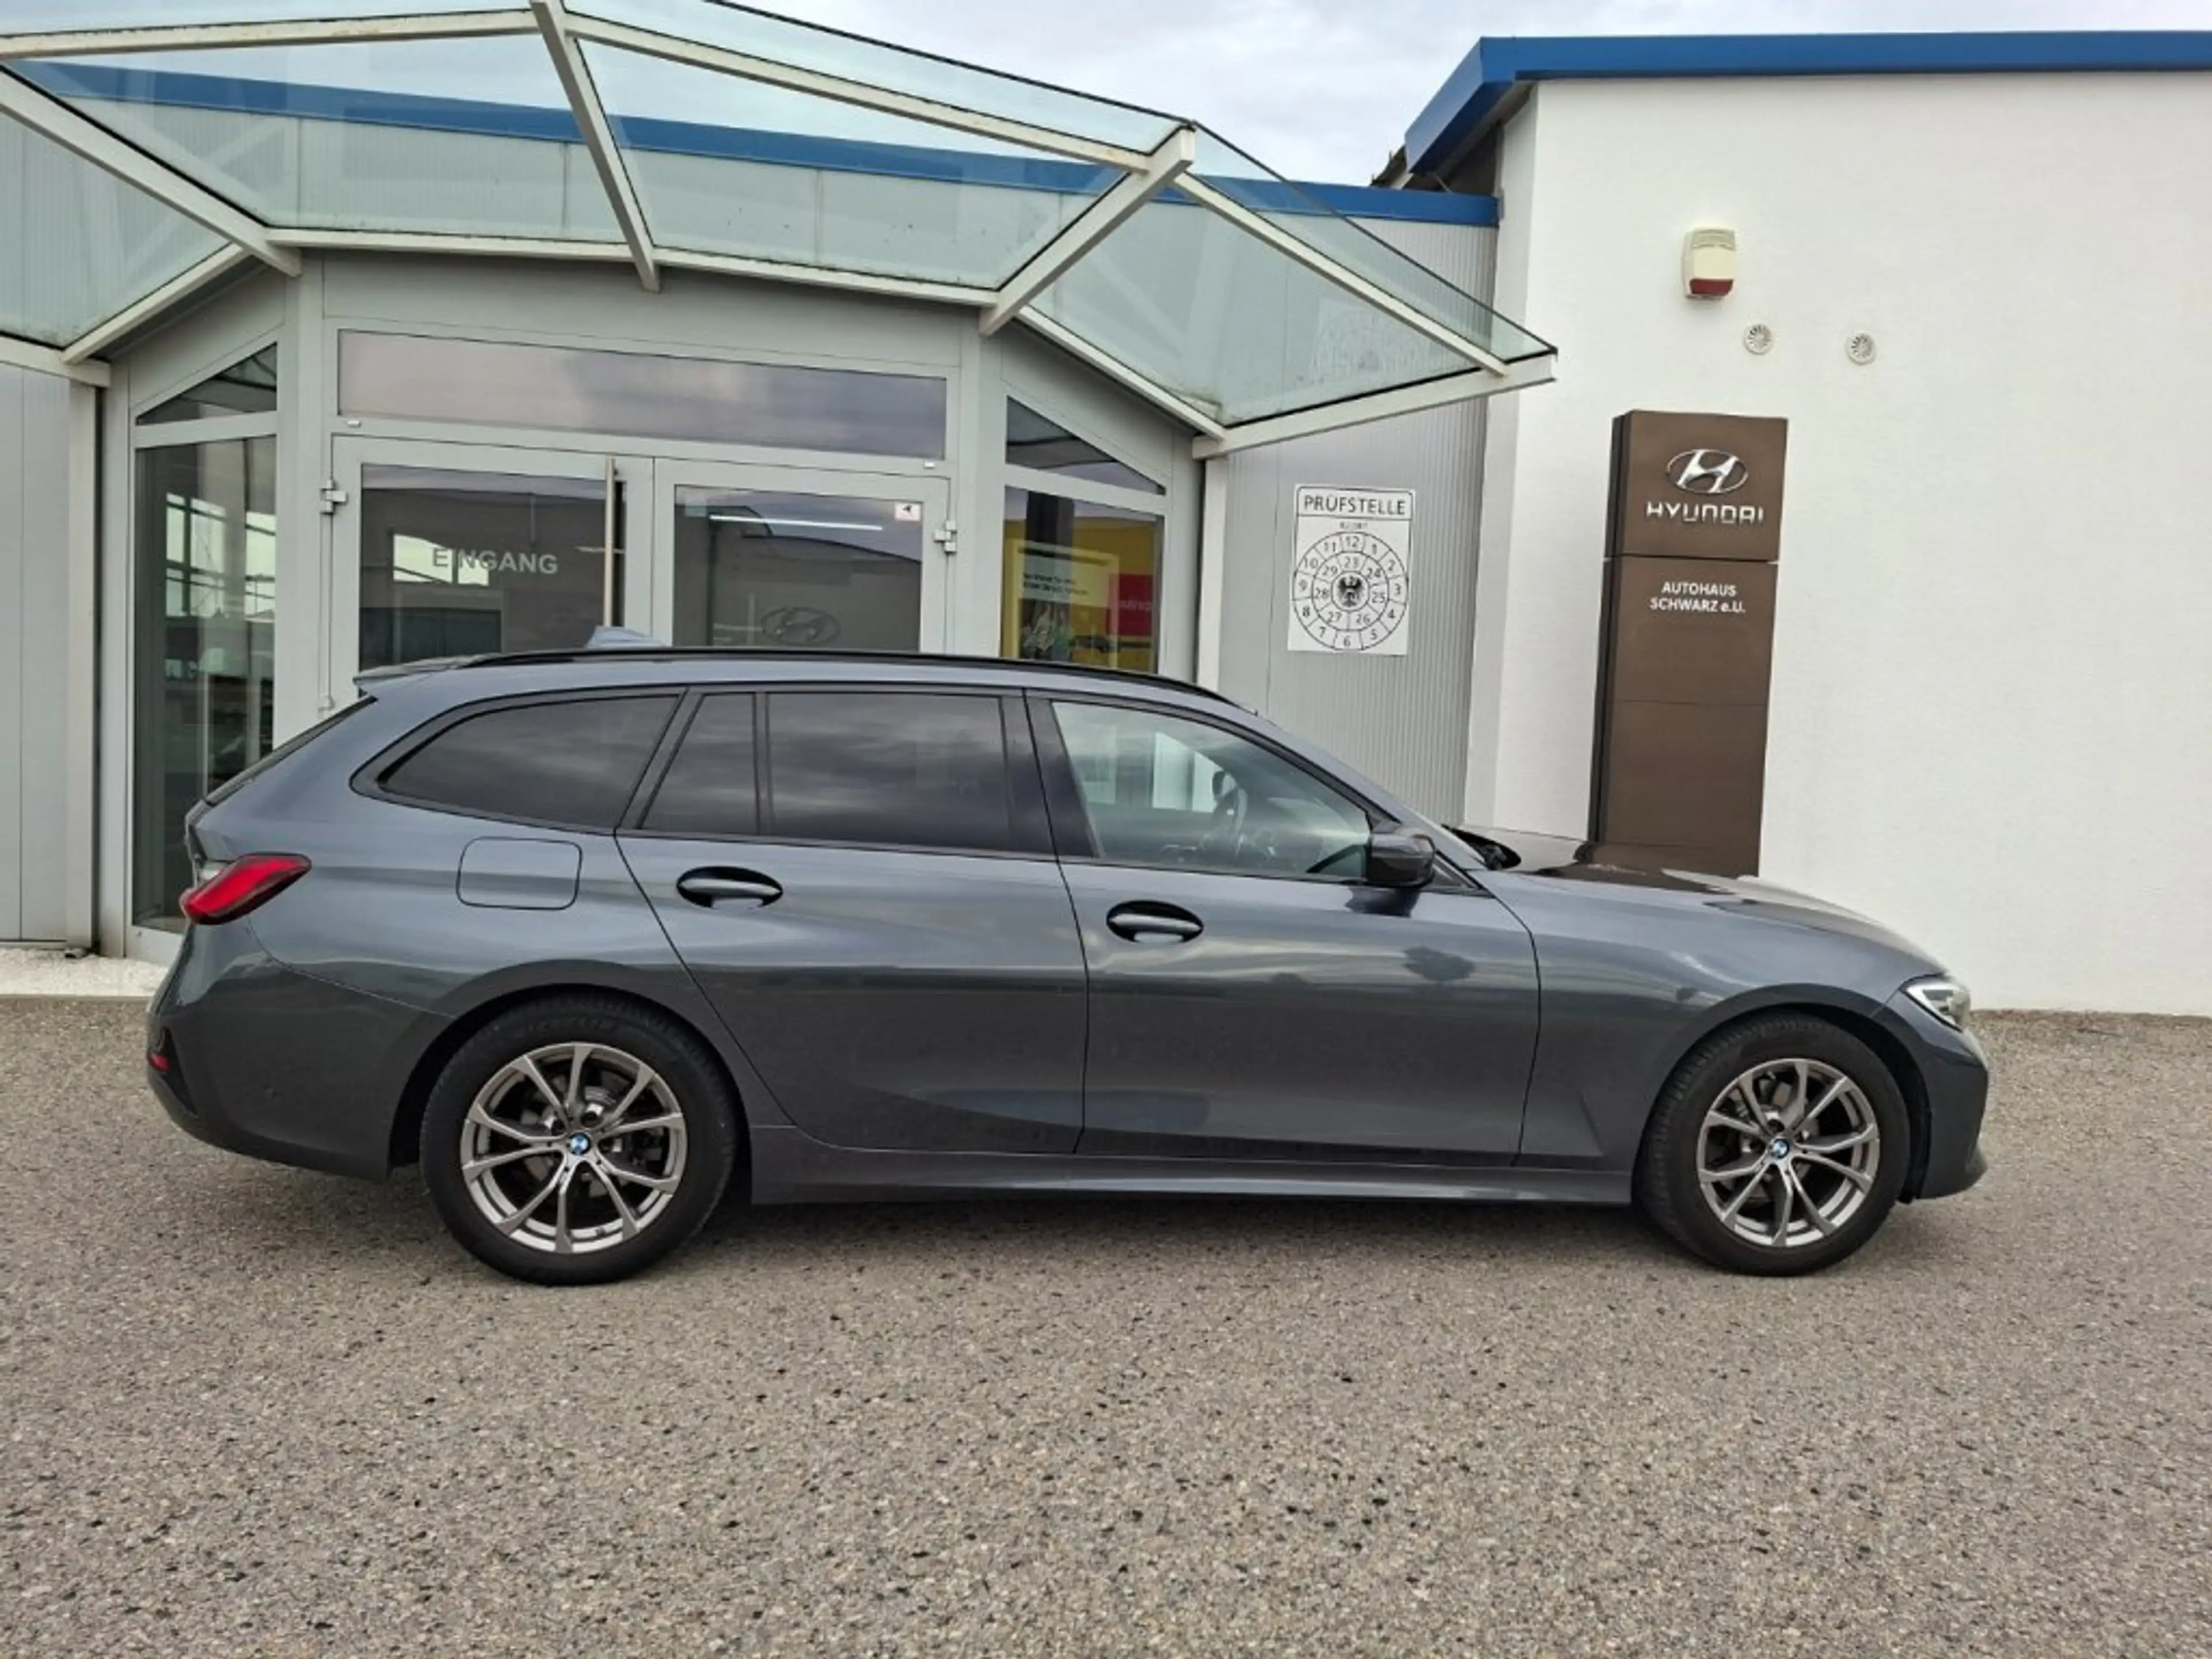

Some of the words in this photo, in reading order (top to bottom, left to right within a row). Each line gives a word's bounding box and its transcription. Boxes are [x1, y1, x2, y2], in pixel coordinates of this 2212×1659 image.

[1304, 494, 1406, 516] PRÜFSTELLE
[1646, 501, 1764, 524] HYUNDAI
[1324, 542, 1336, 552] 11
[1346, 536, 1359, 547] 12
[433, 547, 559, 574] EINGANG
[1304, 556, 1319, 569] 10
[1387, 560, 1396, 571] 2
[1322, 566, 1338, 577] 29
[1394, 583, 1402, 595] 3
[1661, 581, 1737, 596] AUTOHAUS
[1372, 591, 1385, 604] 25
[1650, 597, 1718, 612] SCHWARZ
[1327, 611, 1343, 623] 27
[1355, 613, 1371, 624] 26
[1387, 608, 1396, 619] 4
[1318, 626, 1327, 638] 7
[1370, 628, 1378, 640] 5
[1343, 635, 1351, 647] 6
